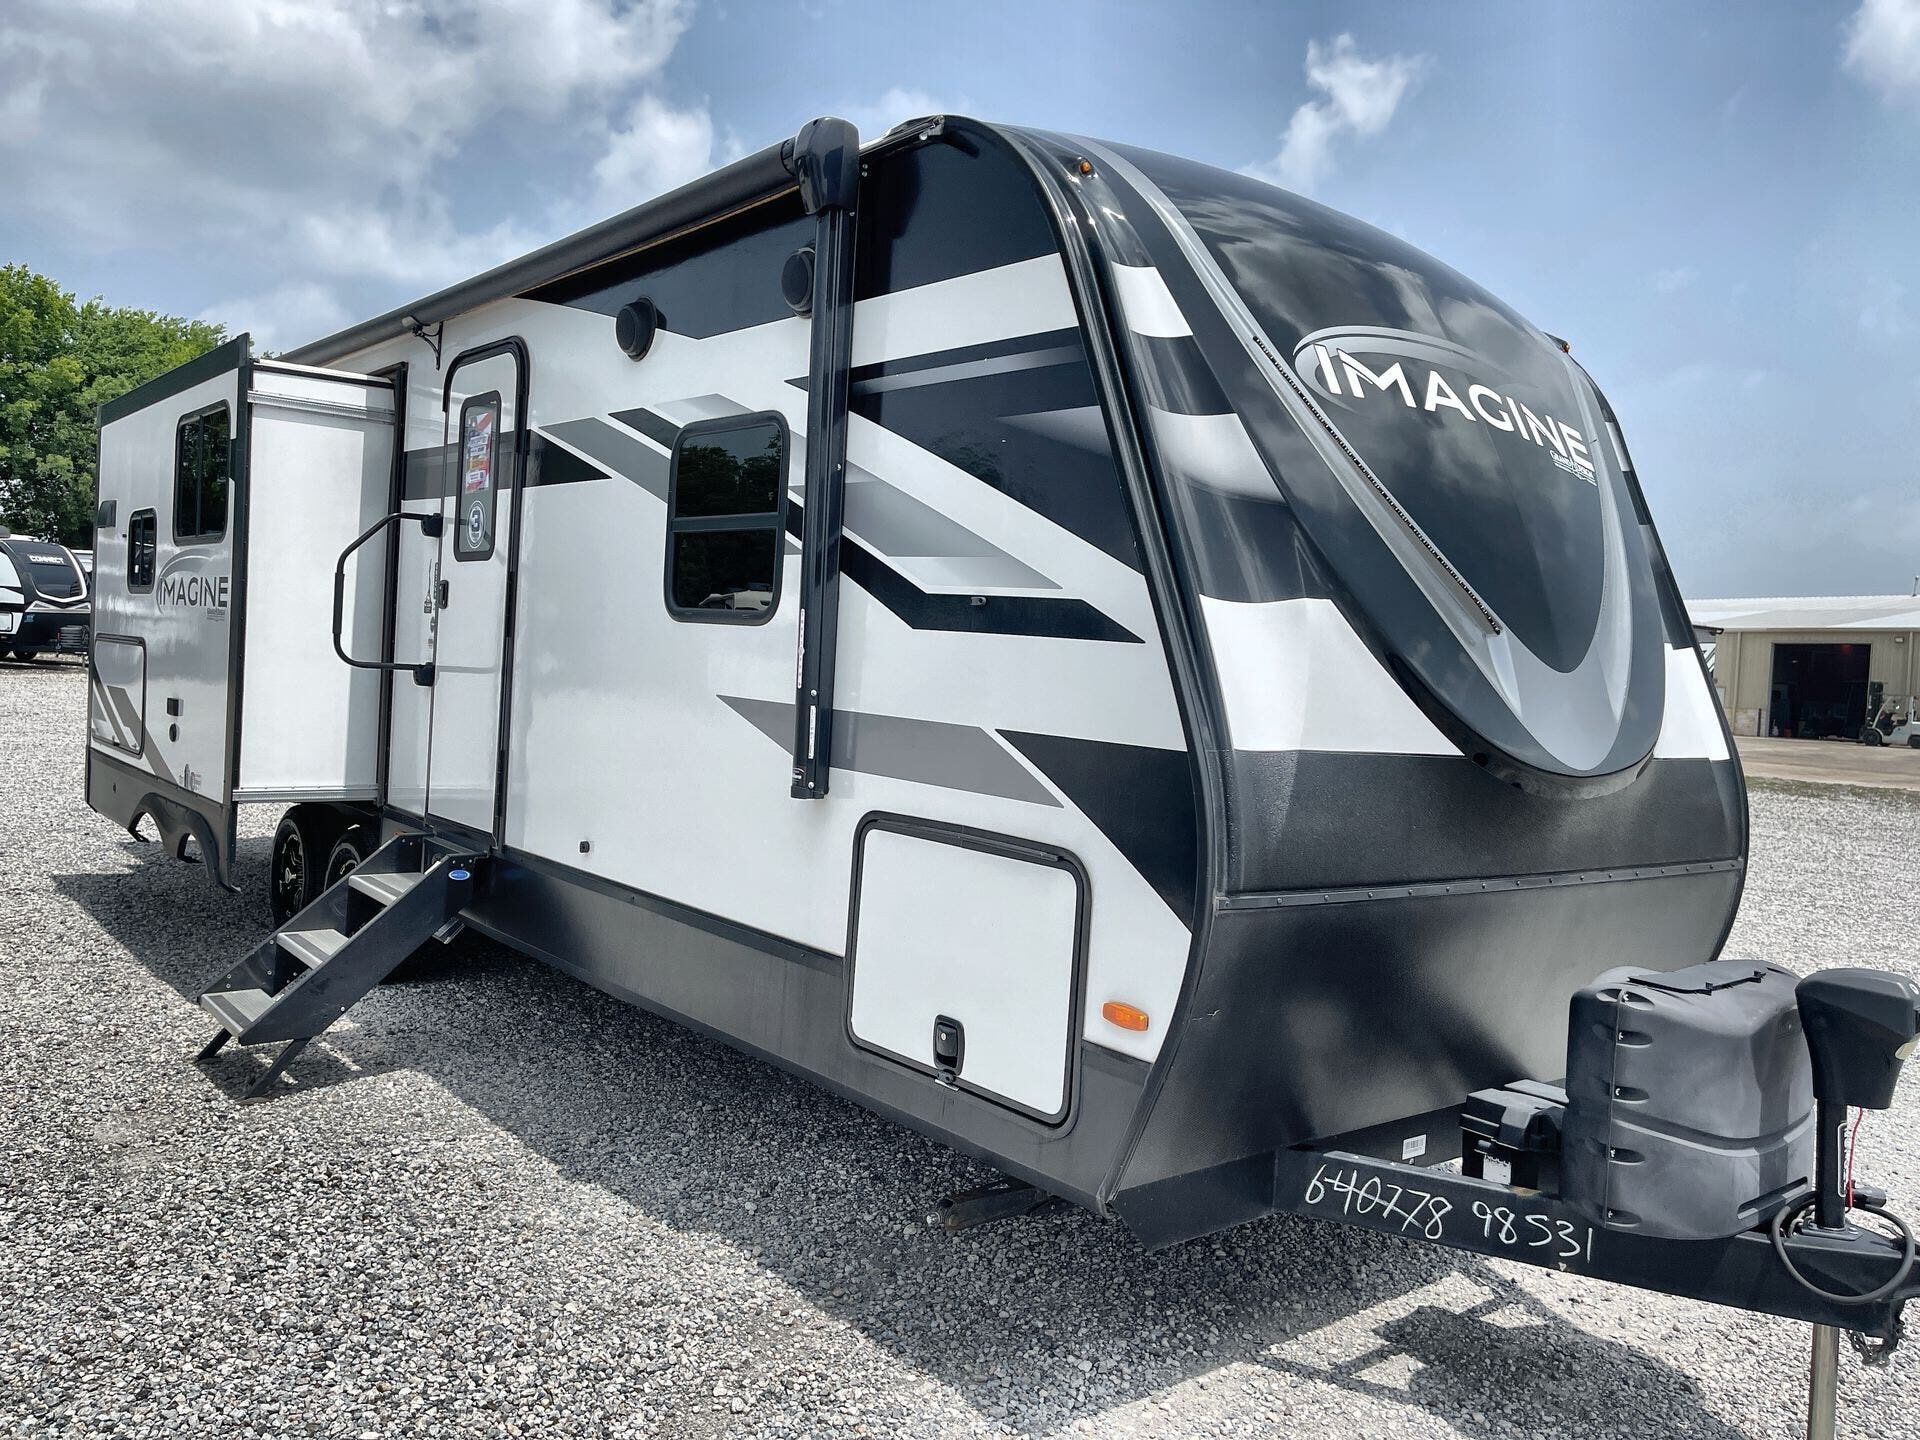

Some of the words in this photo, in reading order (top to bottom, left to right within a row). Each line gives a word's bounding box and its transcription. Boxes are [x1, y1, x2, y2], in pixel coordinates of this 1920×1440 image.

[1313, 344, 1595, 472] IMAGINE
[471, 509, 480, 532] 3
[29, 555, 64, 564] CONNECT
[160, 577, 228, 607] IMAGINE
[1472, 1201, 1593, 1264] 98531
